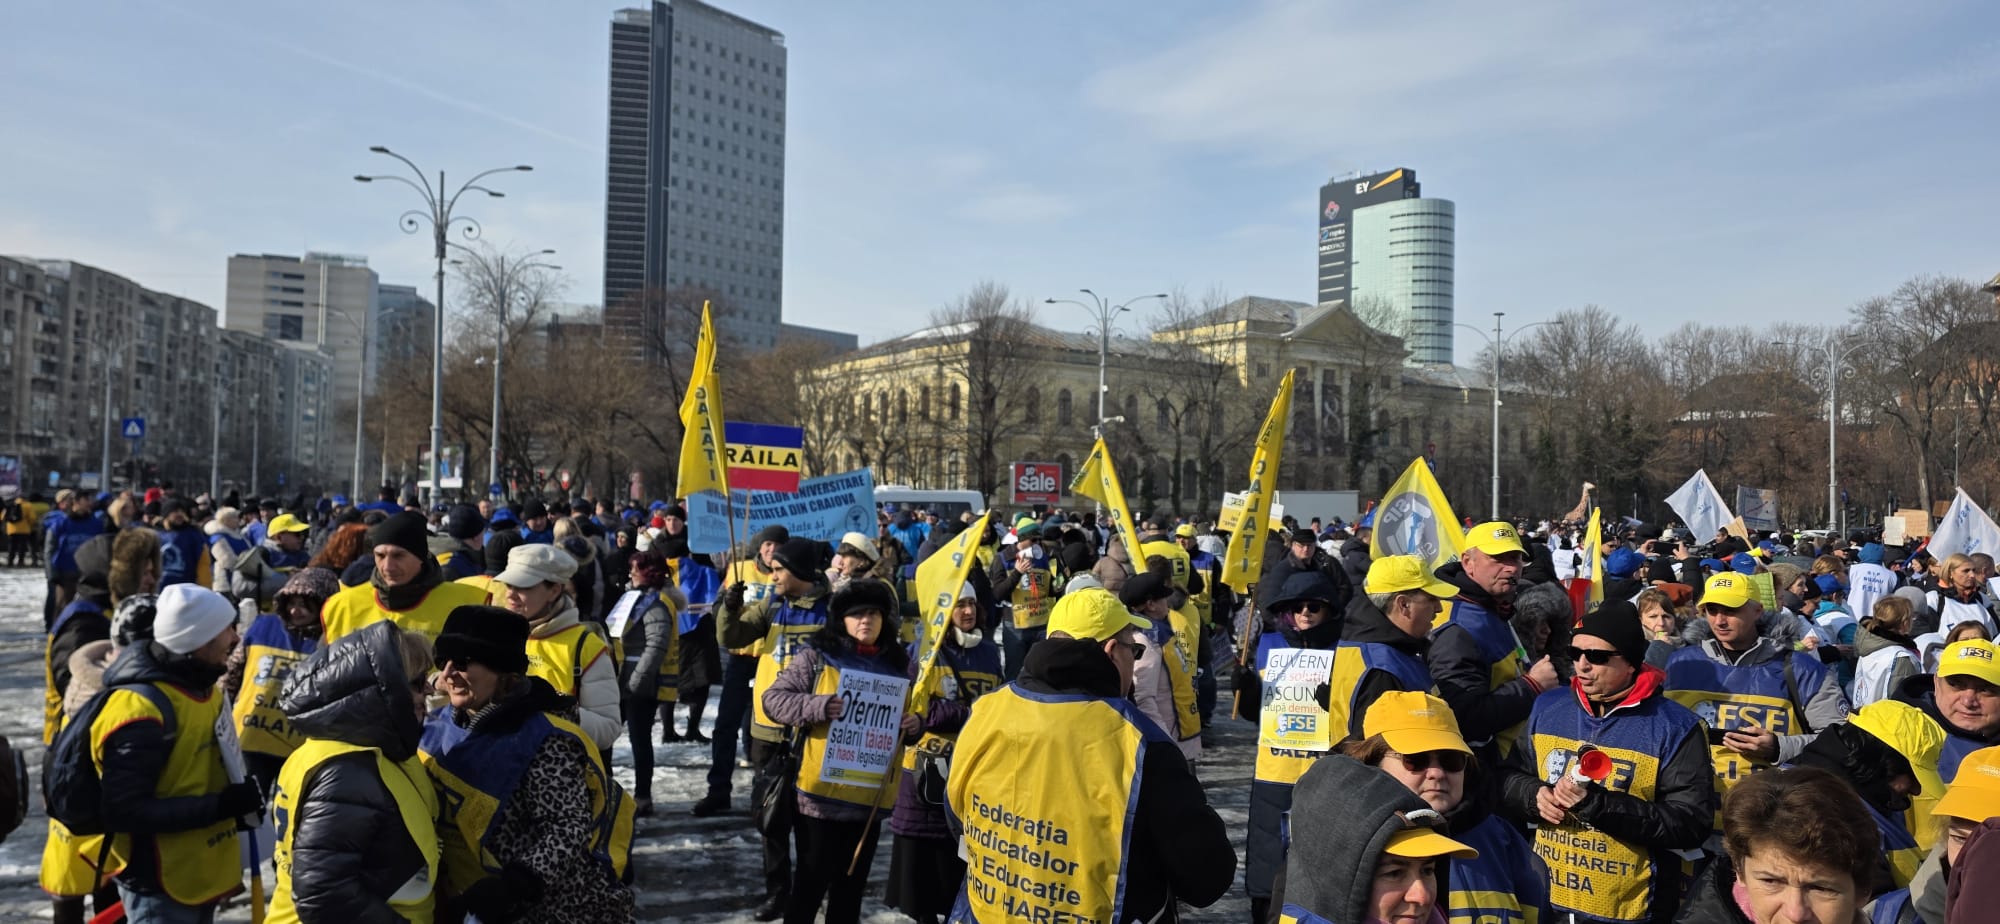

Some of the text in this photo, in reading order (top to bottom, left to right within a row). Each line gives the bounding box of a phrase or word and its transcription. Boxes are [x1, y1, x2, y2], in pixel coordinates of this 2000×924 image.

[1355, 181, 1370, 195] EY
[726, 445, 799, 468] RĂILA
[1019, 472, 1056, 492] sale
[790, 497, 808, 516] DIN
[809, 493, 856, 514] CRAIOVA
[1269, 655, 1329, 670] GUVERN
[1967, 647, 1993, 660] FSE
[1264, 685, 1317, 702] ASCUN
[838, 690, 897, 730] Oferim:
[1717, 703, 1785, 734] FSE
[1287, 716, 1316, 730] FSE
[830, 725, 863, 747] salarii
[835, 746, 855, 761] haos
[972, 793, 1069, 846] Federația
[965, 815, 1080, 877] Sindicatelor
[1540, 826, 1608, 854] Sindicală
[982, 855, 1082, 908] Educație
